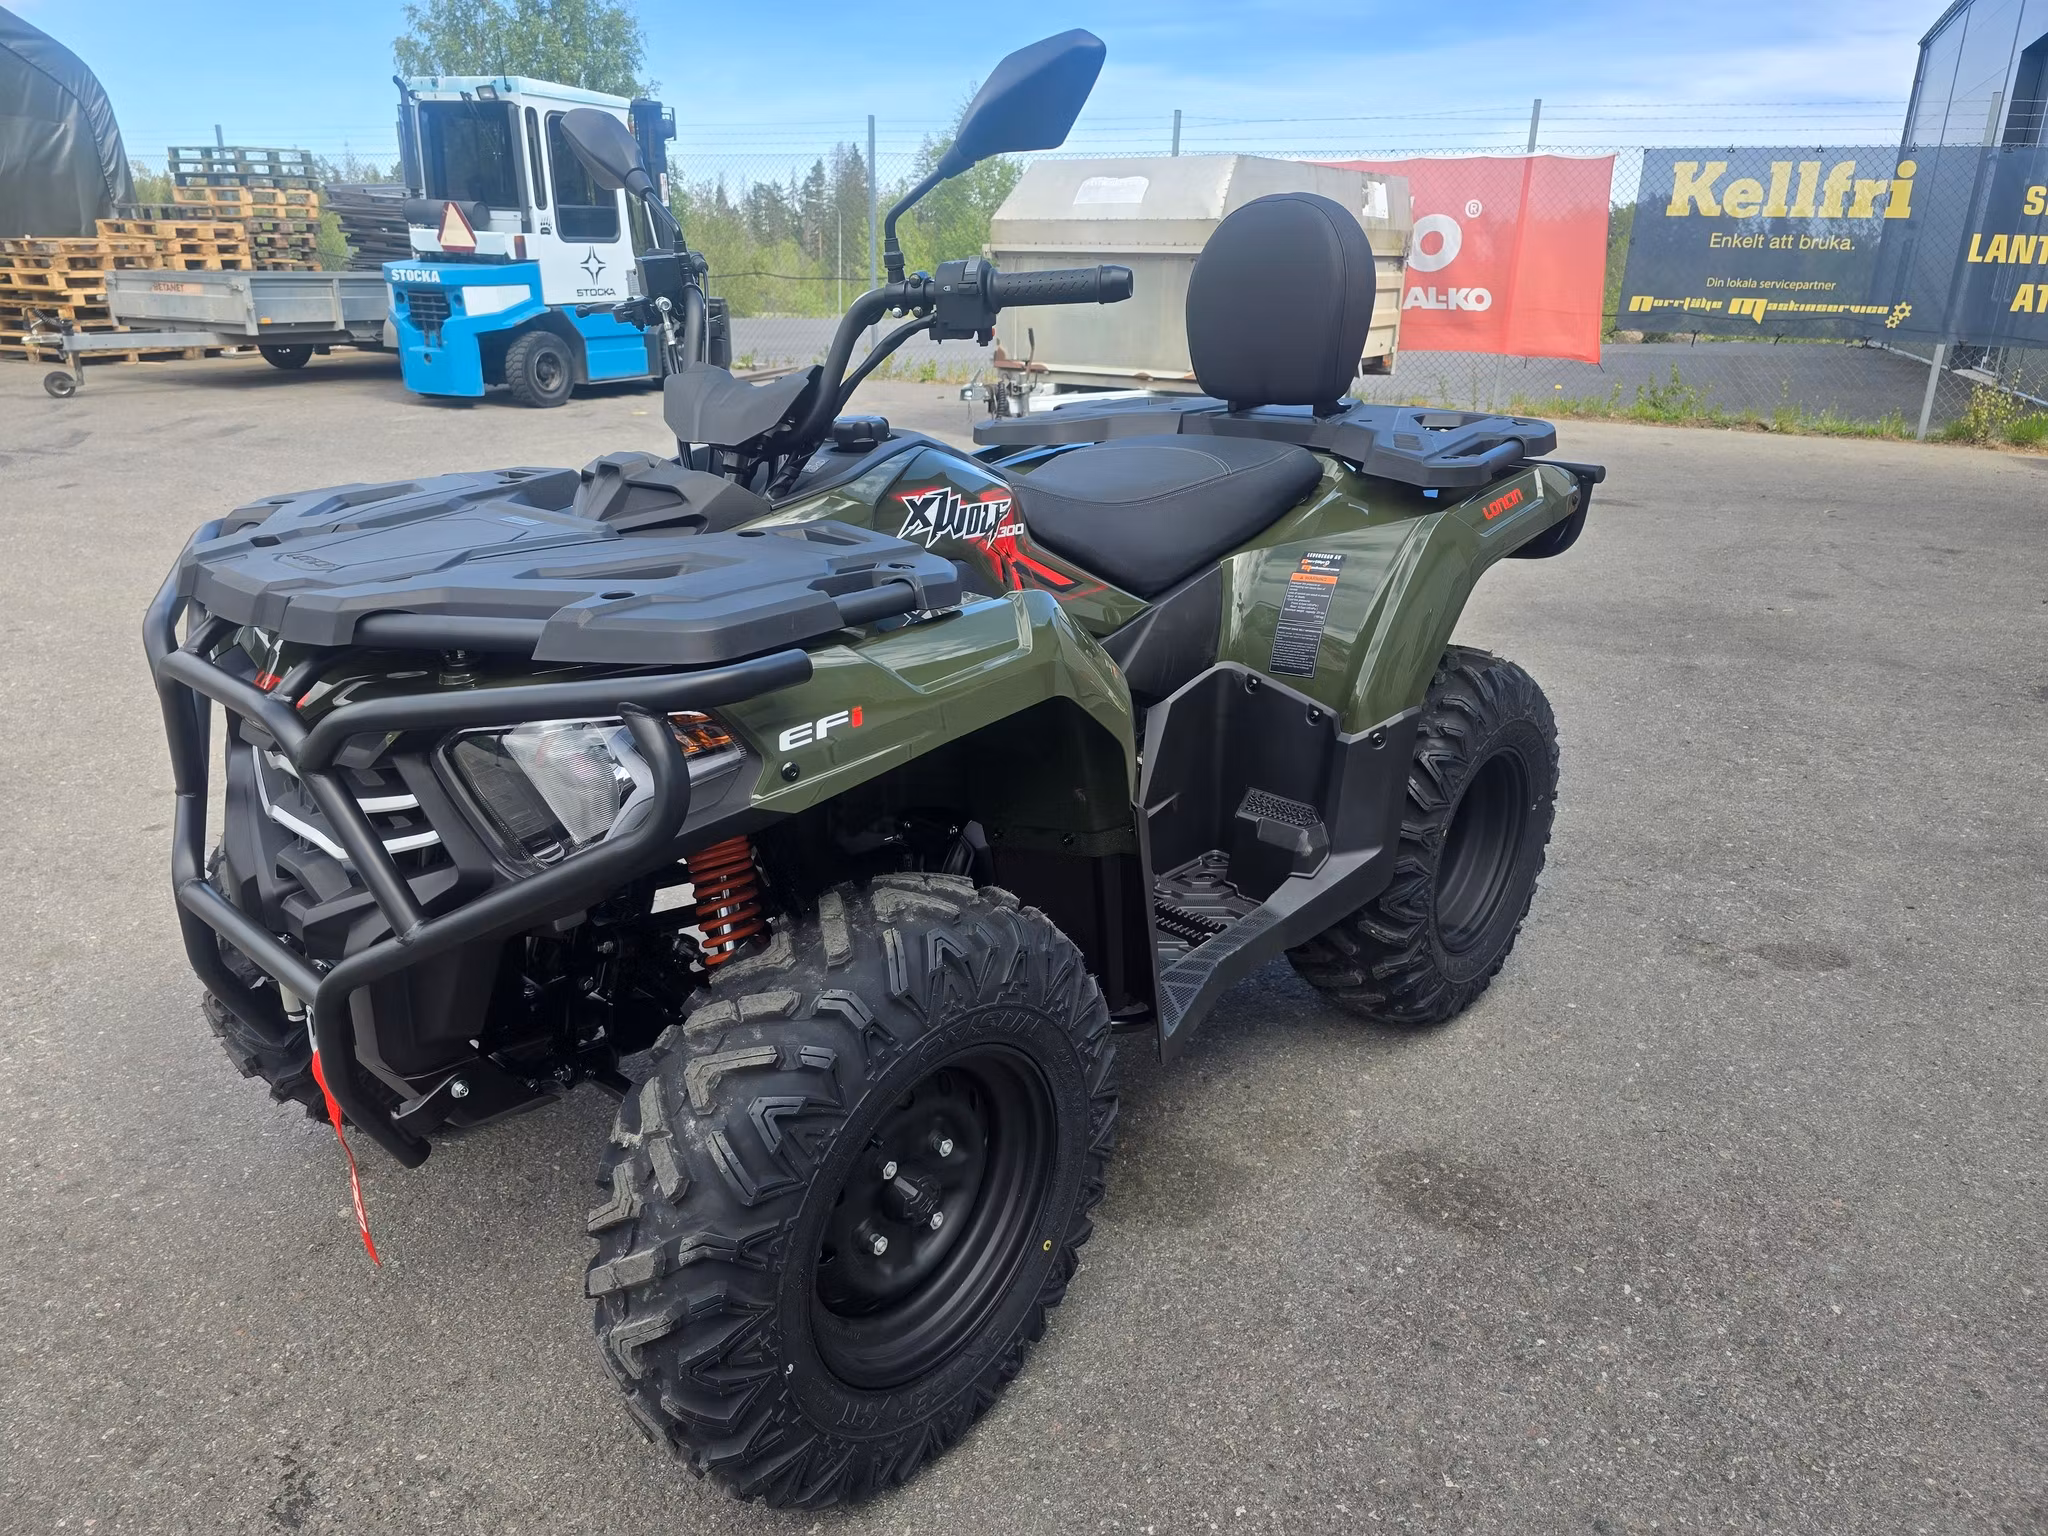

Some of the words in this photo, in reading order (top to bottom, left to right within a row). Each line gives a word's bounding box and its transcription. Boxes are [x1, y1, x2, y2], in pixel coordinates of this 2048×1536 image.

[1666, 160, 1918, 219] Kellfri
[2023, 185, 2048, 216] S
[1709, 232, 1765, 249] Enkelt
[1769, 234, 1794, 249] att
[1799, 234, 1856, 251] bruka.
[391, 269, 441, 283] STOCKA
[1706, 277, 1725, 288] Din
[1726, 277, 1757, 289] lokala
[1759, 279, 1837, 292] servicepartner
[576, 288, 616, 297] STOCKA
[1402, 286, 1493, 312] AL-KO
[997, 523, 1025, 538] 300
